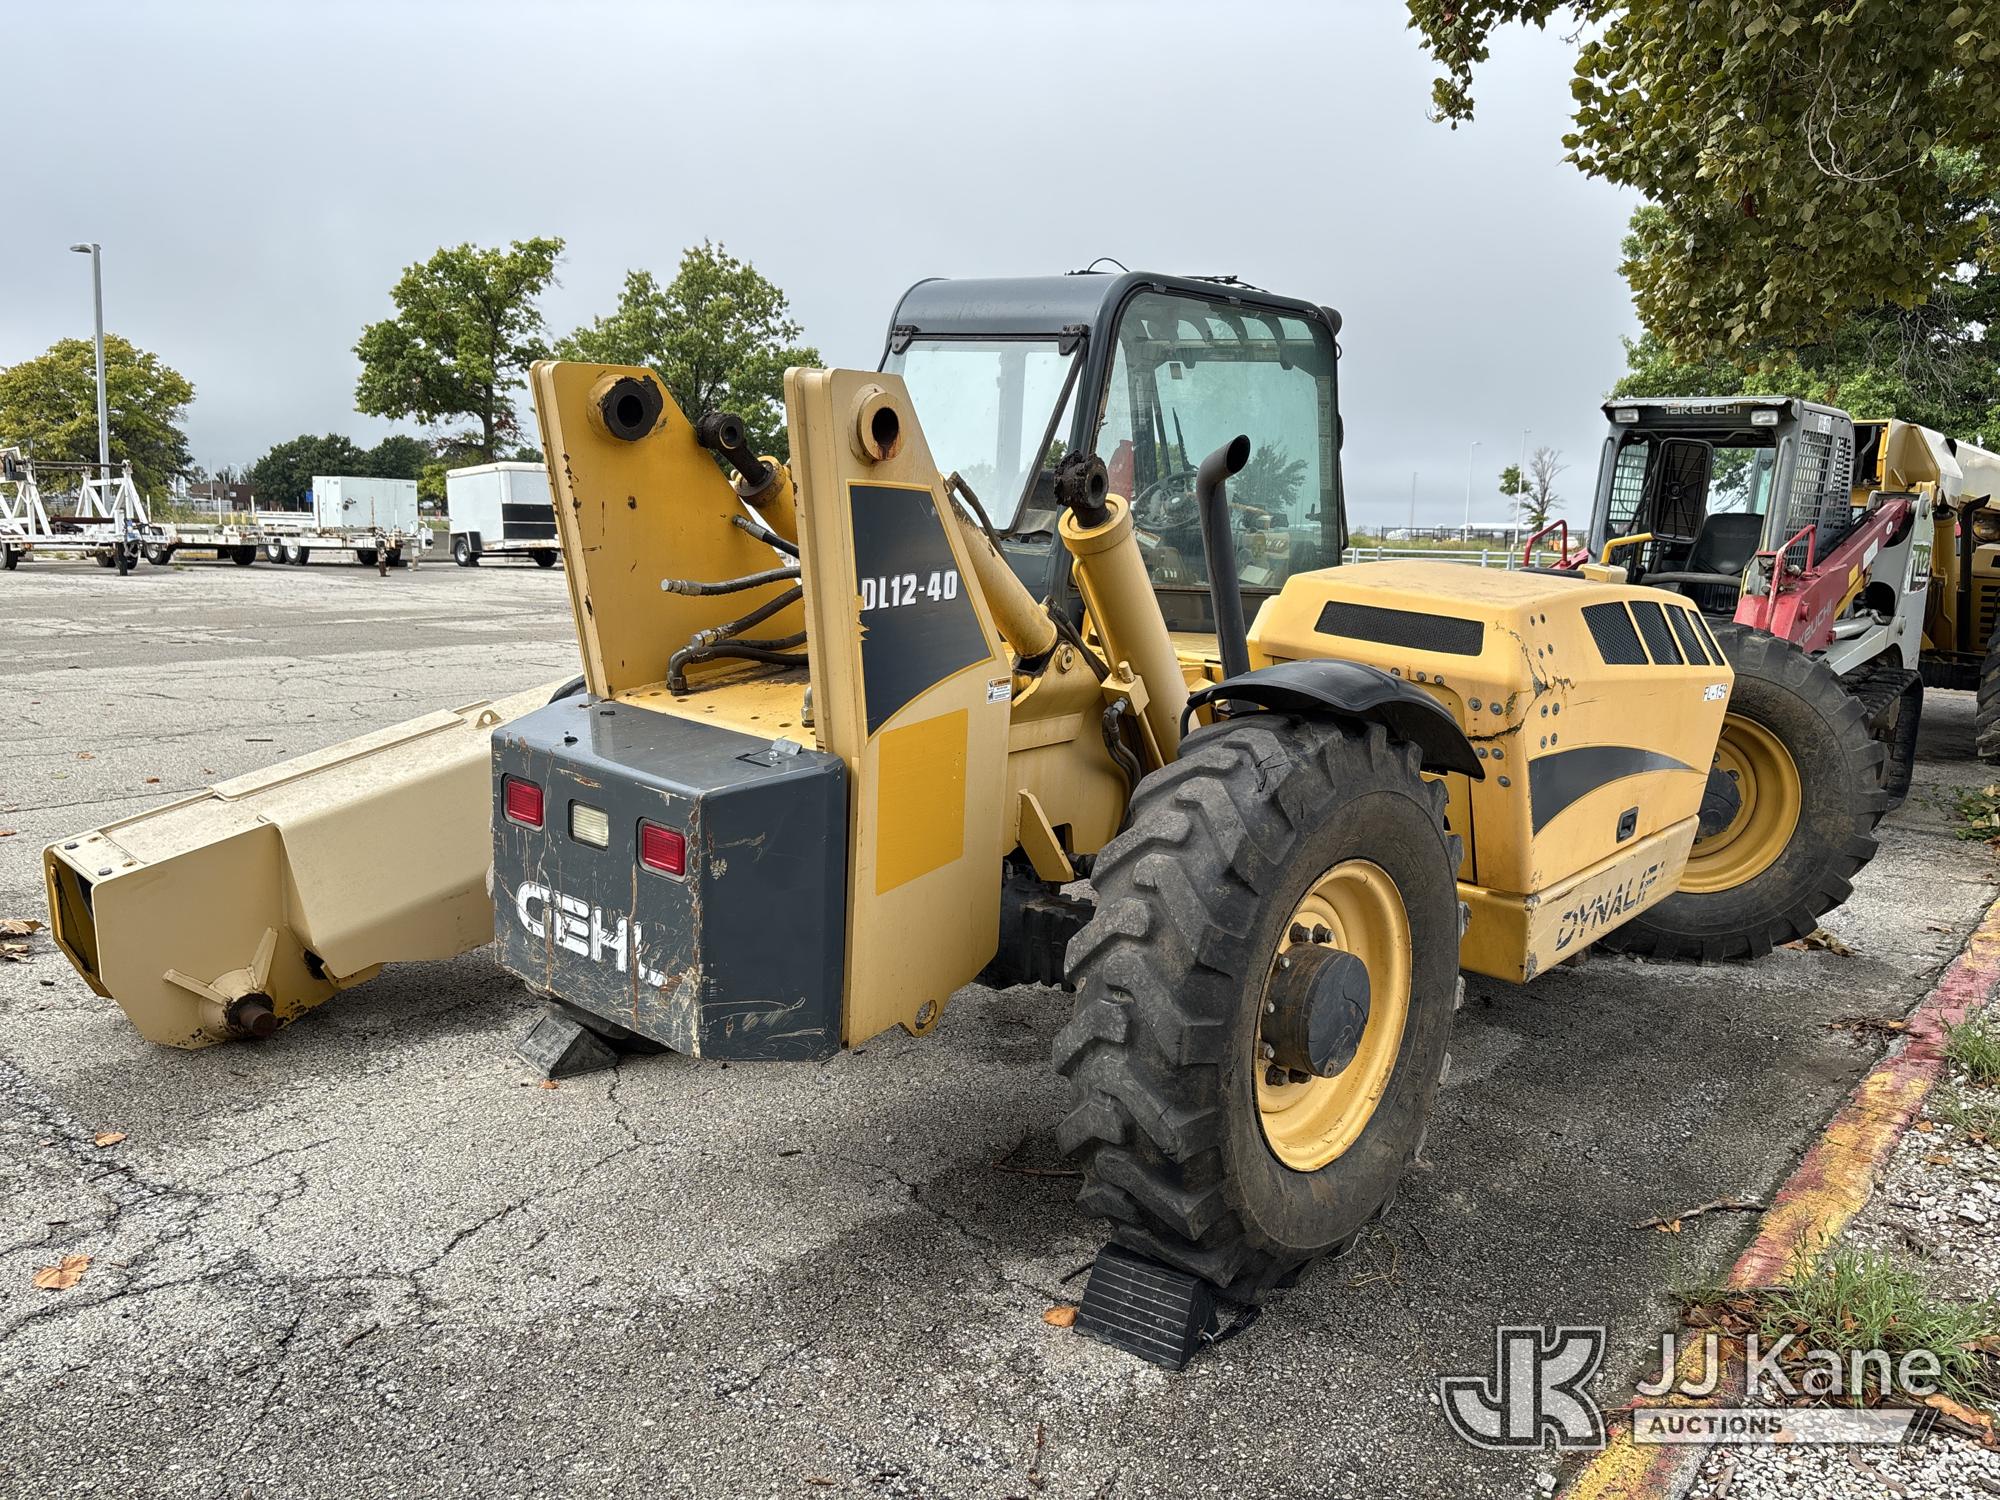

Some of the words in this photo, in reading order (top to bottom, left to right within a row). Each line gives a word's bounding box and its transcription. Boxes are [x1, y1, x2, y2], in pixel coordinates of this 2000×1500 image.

[860, 569, 958, 611] DL12-40
[516, 880, 668, 988] GEHL
[1555, 860, 1666, 951] DYNALIF
